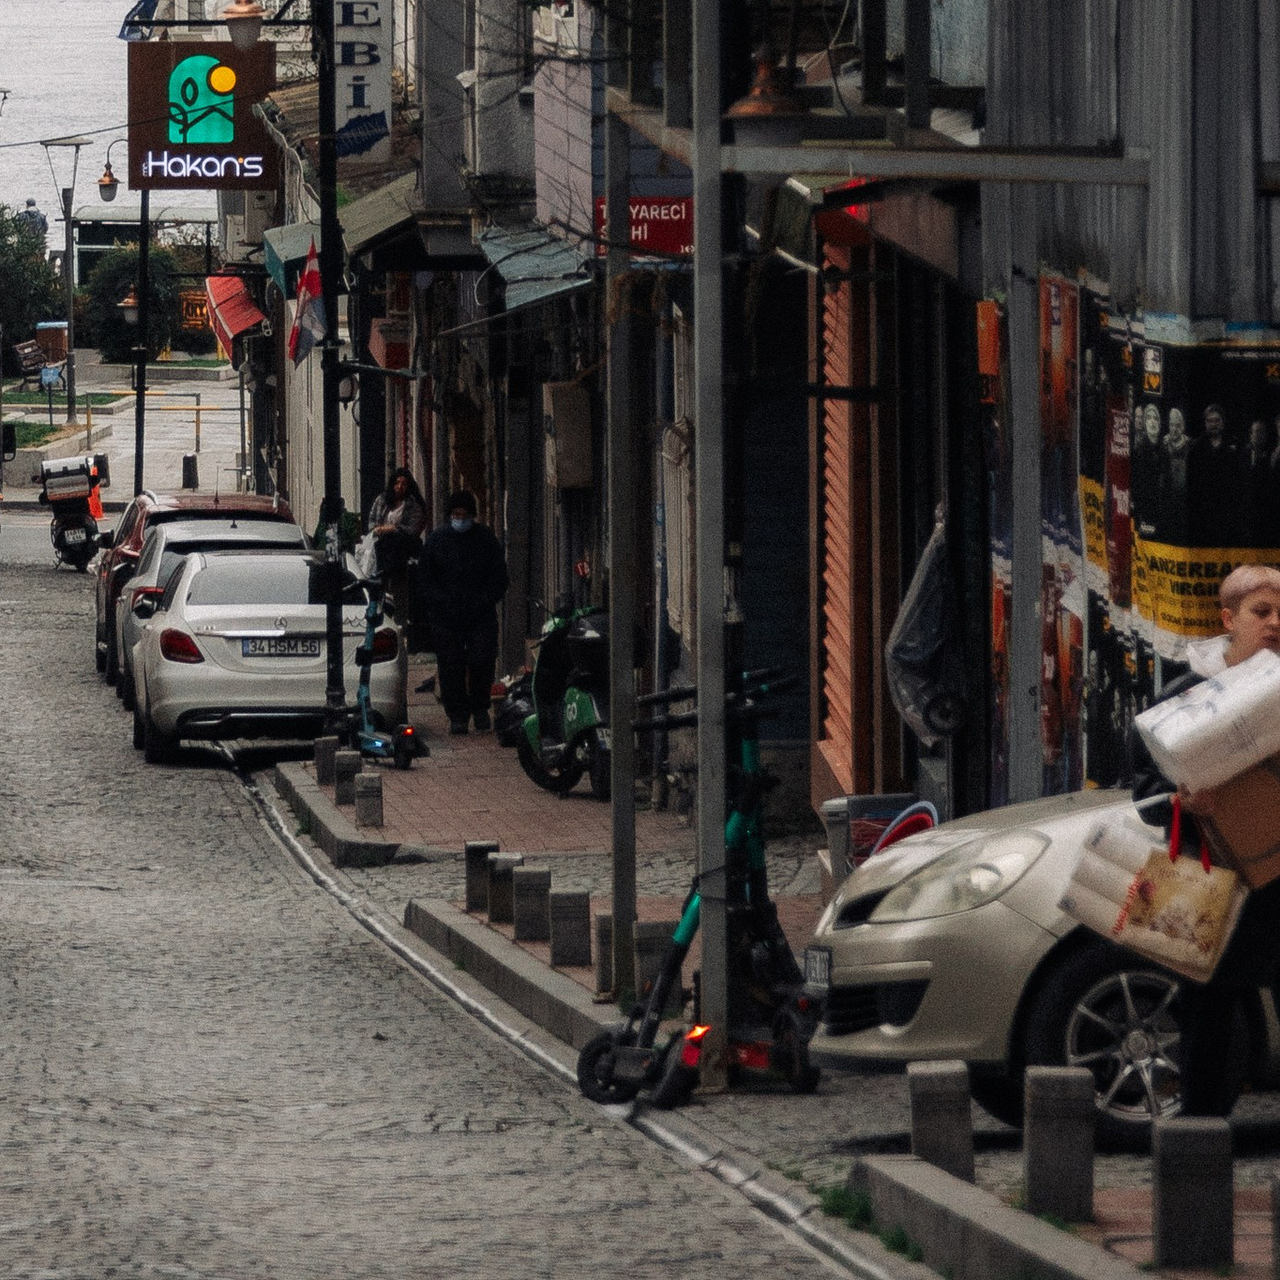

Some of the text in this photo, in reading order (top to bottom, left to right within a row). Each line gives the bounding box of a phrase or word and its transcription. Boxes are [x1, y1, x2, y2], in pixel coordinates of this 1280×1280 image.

[599, 202, 687, 221] TYARECİ
[600, 222, 648, 241] SHİ
[250, 640, 317, 653] 34 HSM 56
